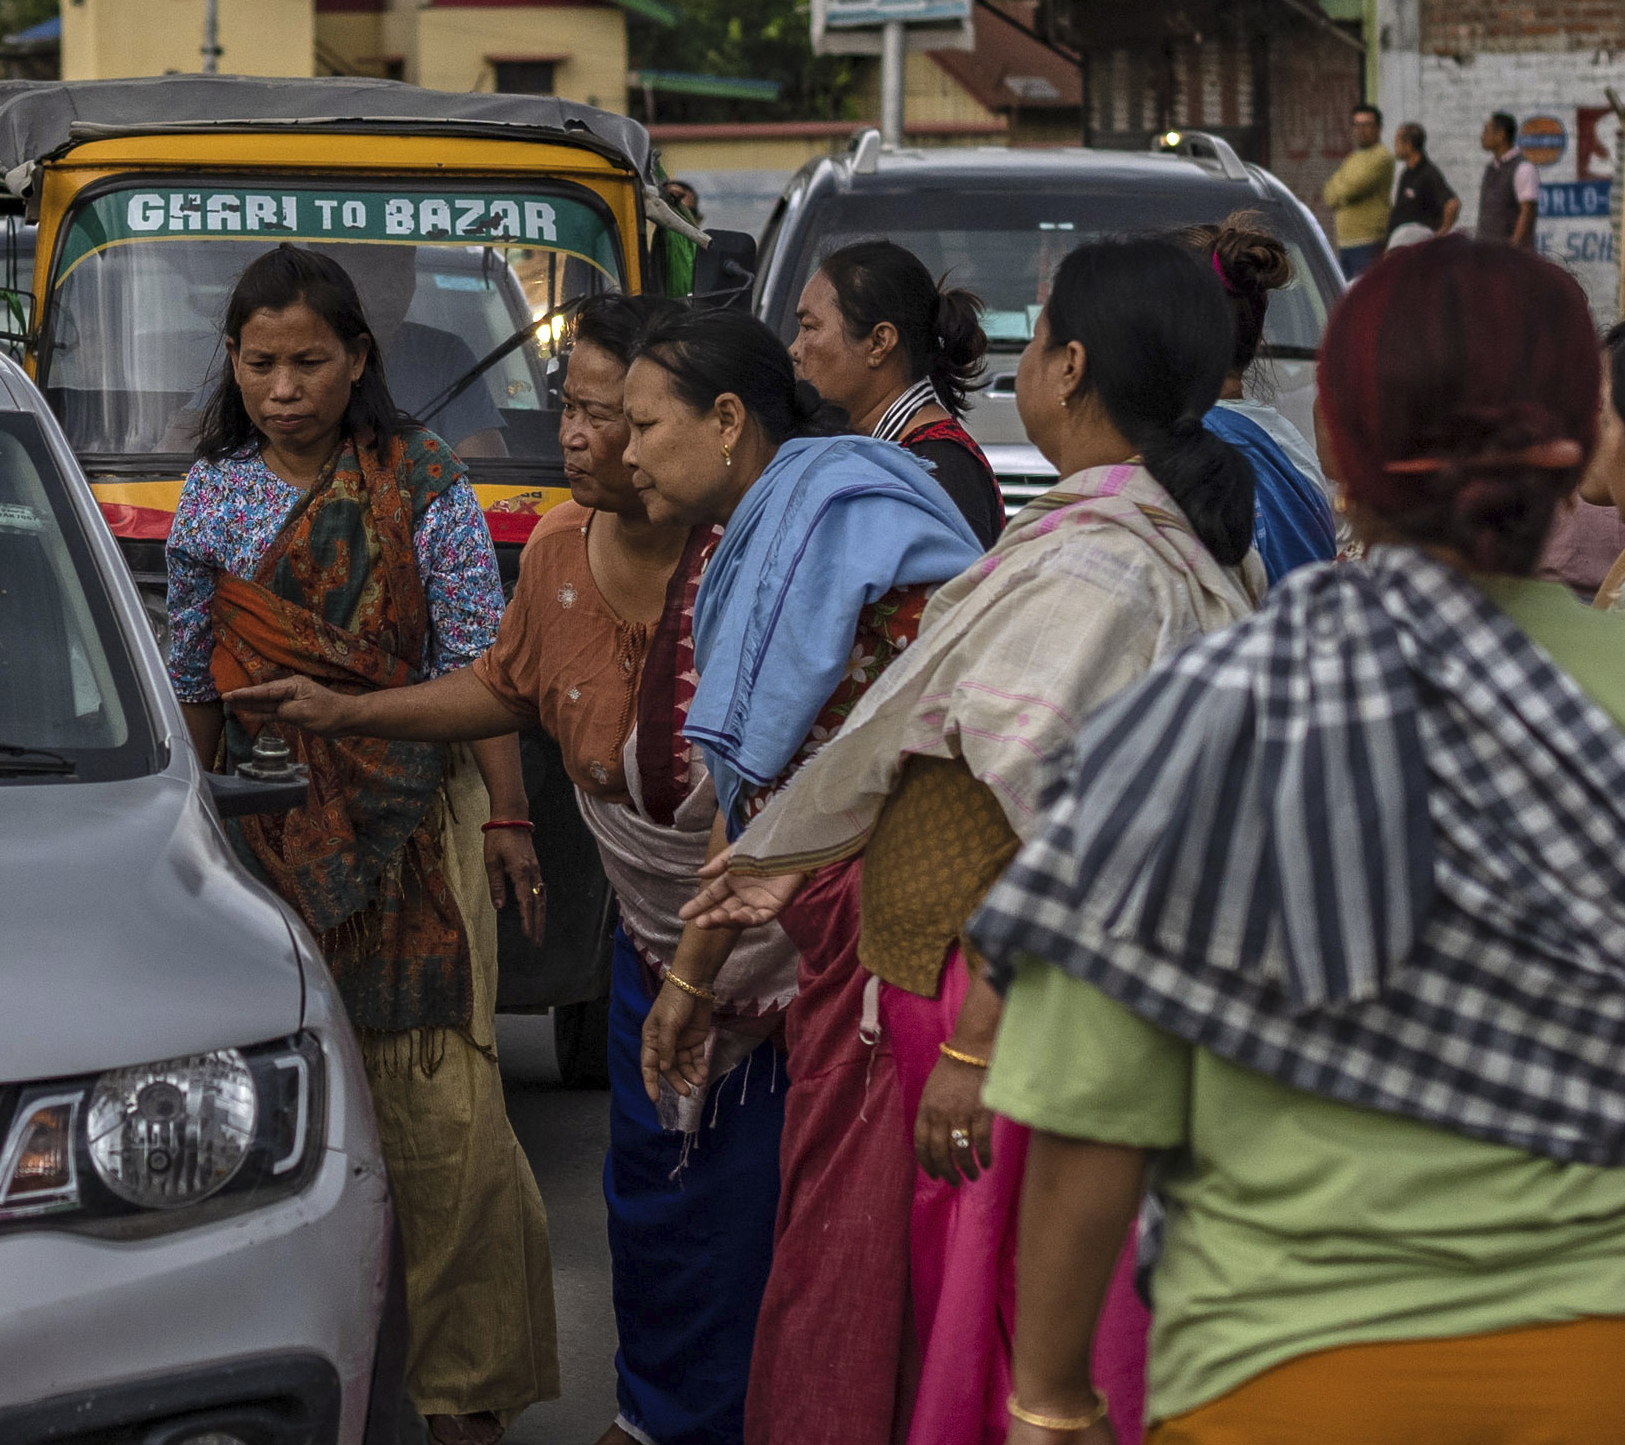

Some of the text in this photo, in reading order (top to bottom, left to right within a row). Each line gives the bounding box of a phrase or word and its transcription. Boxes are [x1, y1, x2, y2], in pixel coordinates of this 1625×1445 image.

[127, 193, 558, 242] GHARI TO BAZAR
